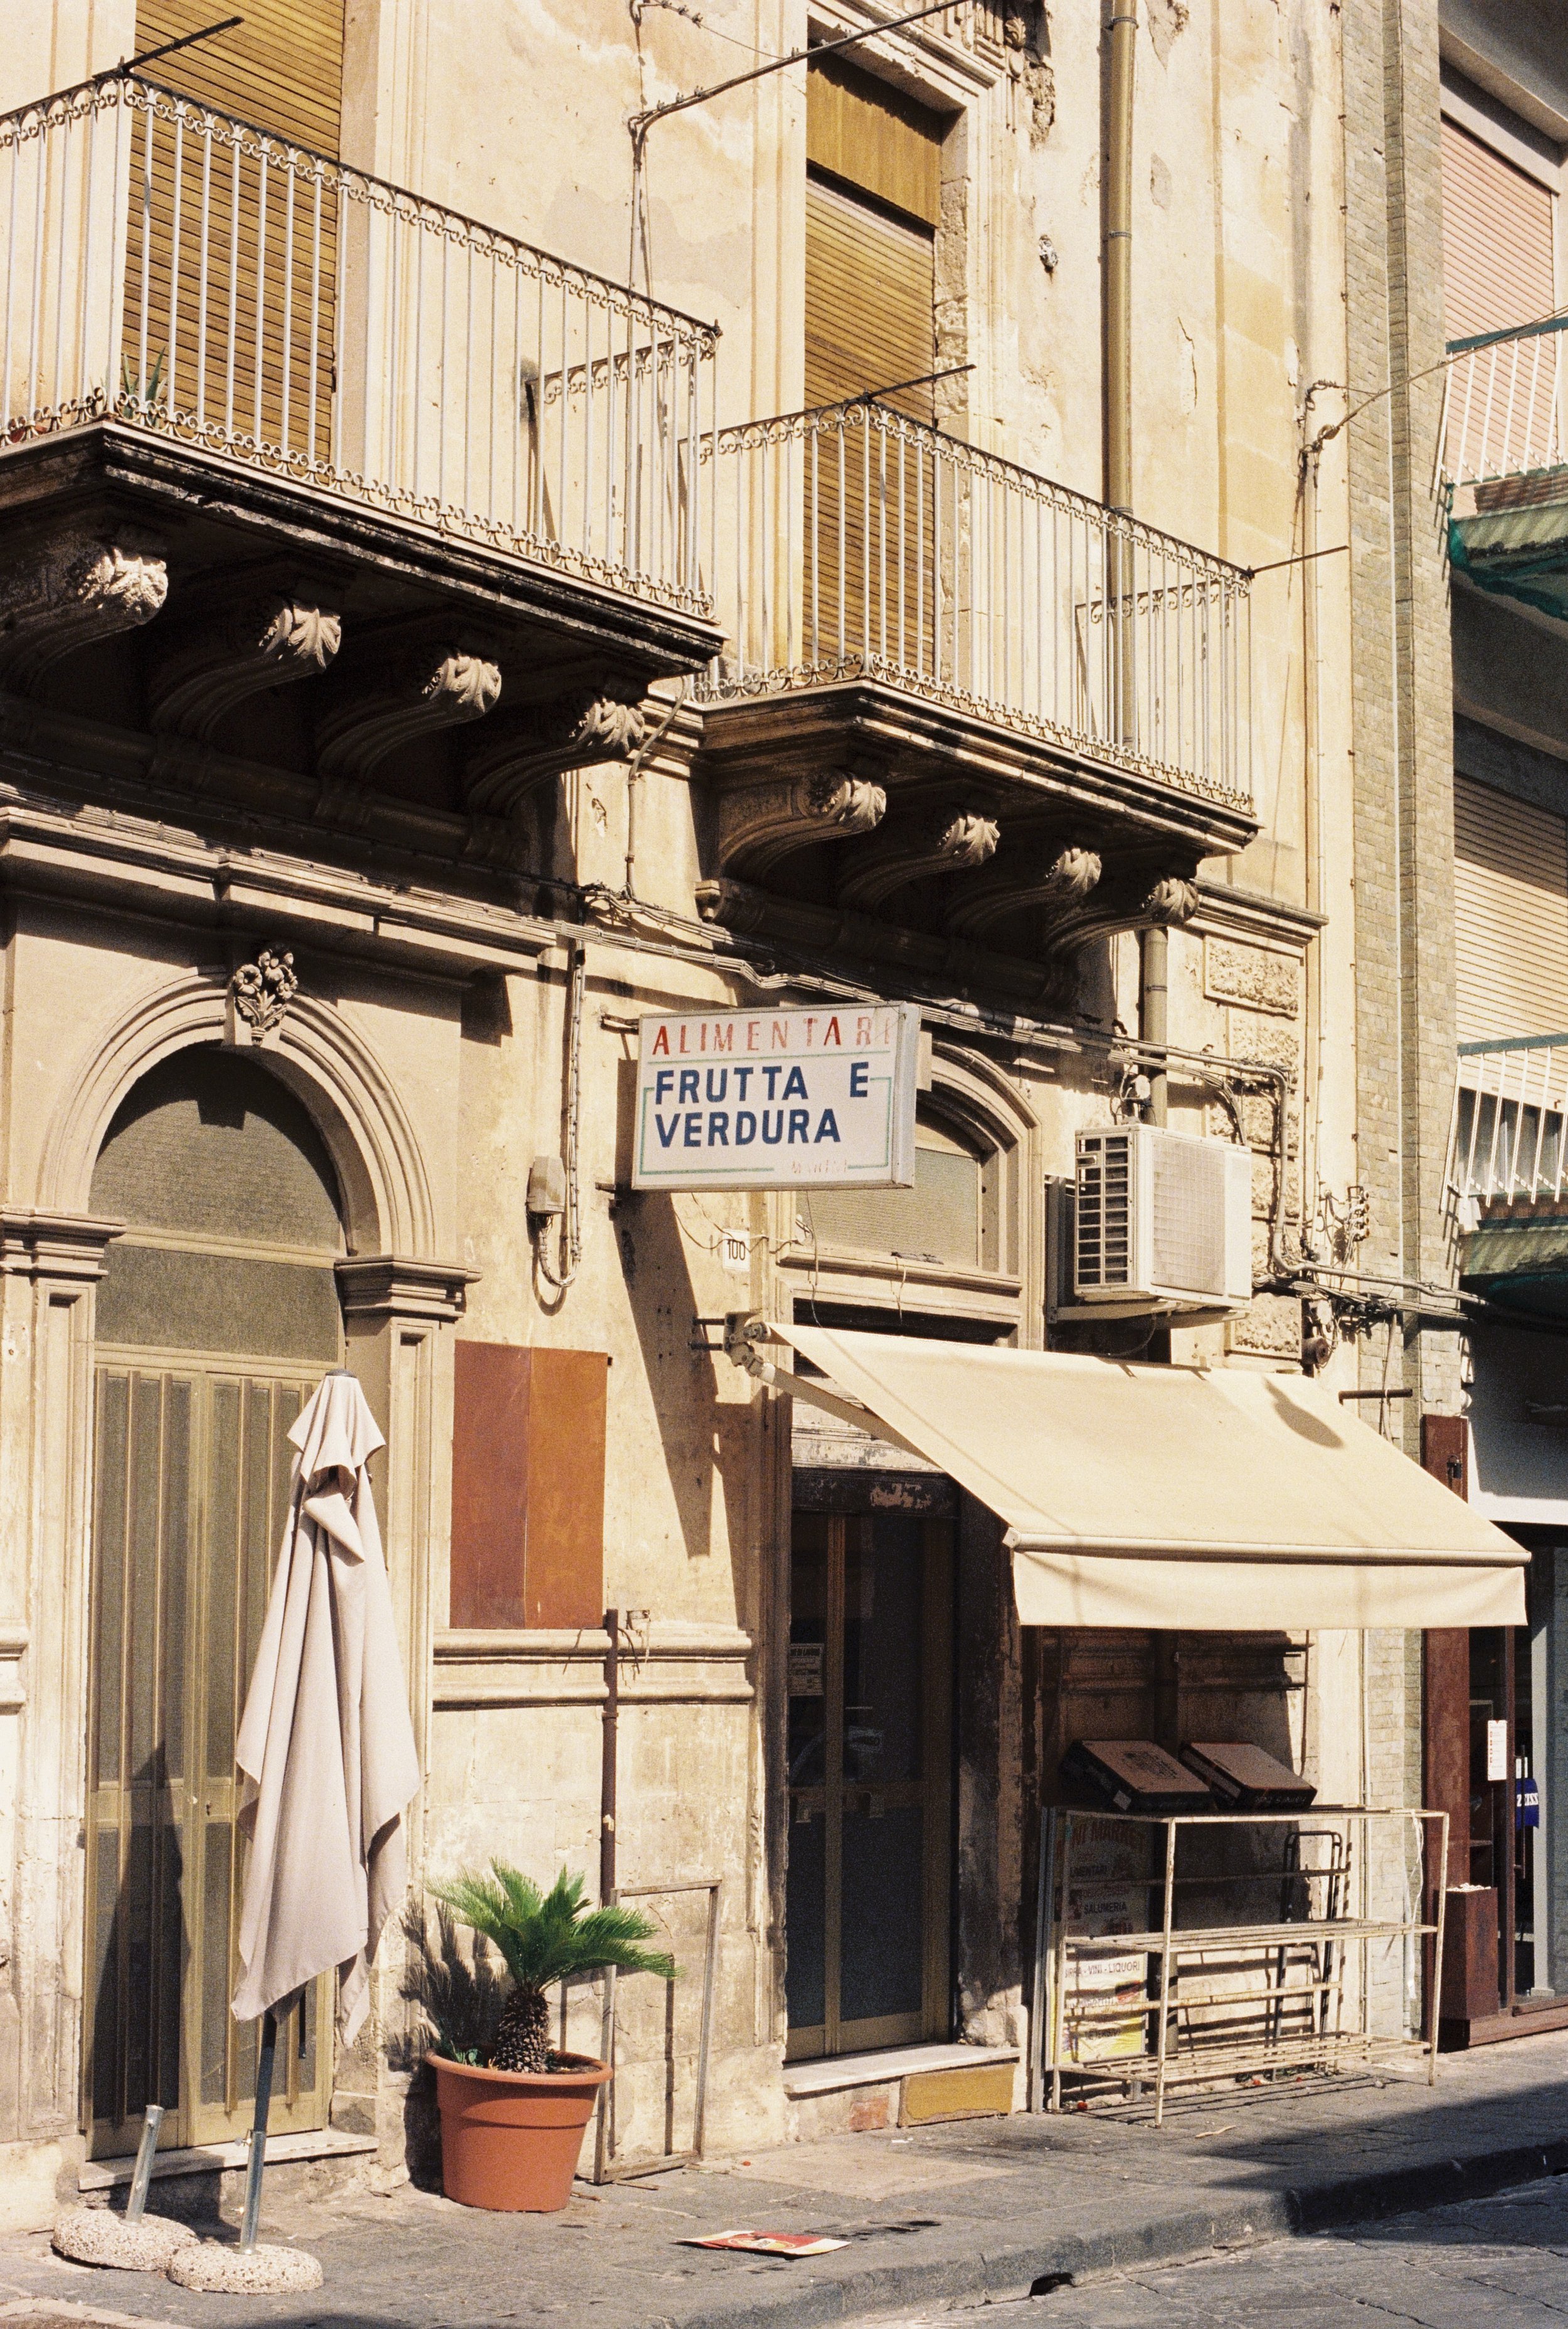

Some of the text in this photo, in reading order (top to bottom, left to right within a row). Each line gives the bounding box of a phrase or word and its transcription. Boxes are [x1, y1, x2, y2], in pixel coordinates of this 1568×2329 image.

[652, 1016, 890, 1056] ALIMENTARI
[655, 1061, 870, 1105] FRUTTA E
[655, 1108, 841, 1149] VERDURA
[727, 1239, 746, 1261] 100
[1084, 1901, 1128, 1915] SALUMERIA
[1088, 1963, 1103, 1975] VINI
[1108, 1961, 1140, 1973] LIQUORI
